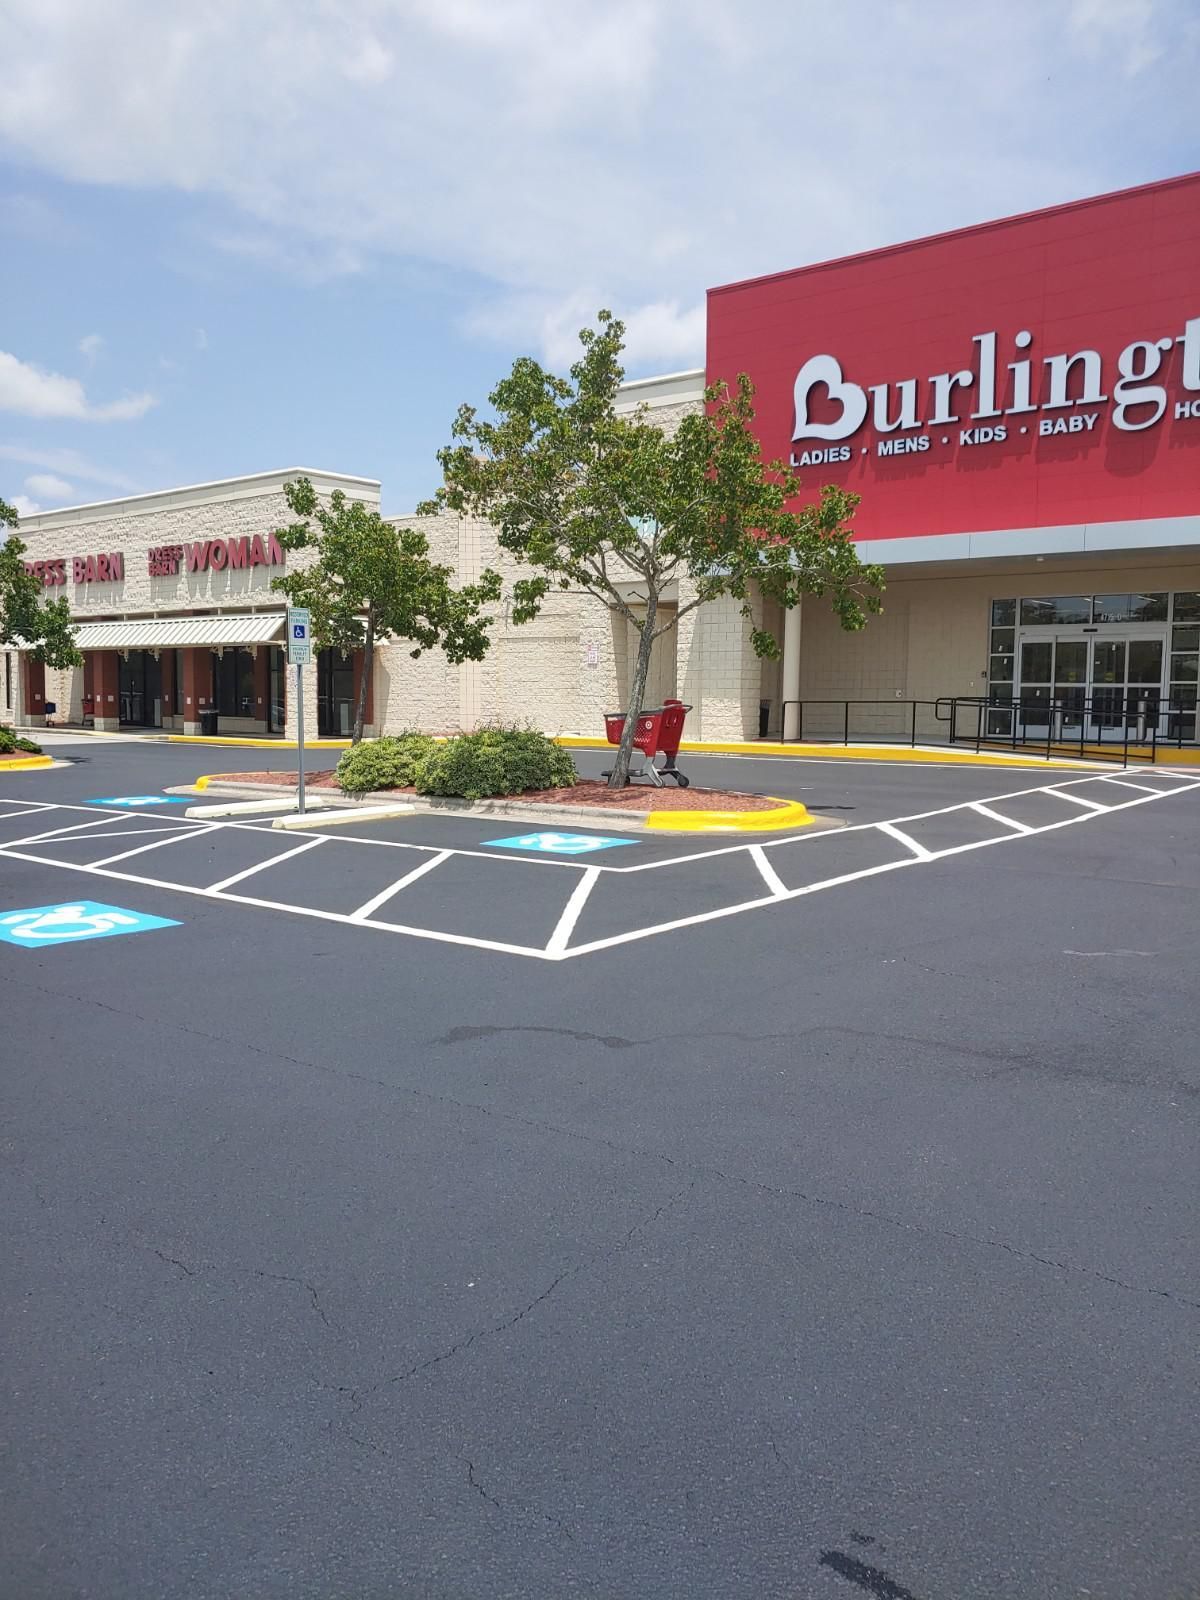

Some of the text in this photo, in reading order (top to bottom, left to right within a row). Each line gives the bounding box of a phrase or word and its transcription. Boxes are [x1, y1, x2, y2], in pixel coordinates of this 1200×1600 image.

[791, 316, 1200, 441] Burlingt
[790, 446, 851, 467] LADIES
[877, 435, 931, 457] MENS
[959, 425, 1008, 446] KIDS
[1038, 413, 1099, 436] BABY
[23, 552, 125, 587] RESS BARN
[147, 544, 183, 562] DRESS
[147, 560, 180, 577] BARN
[183, 532, 286, 573] WOMAN
